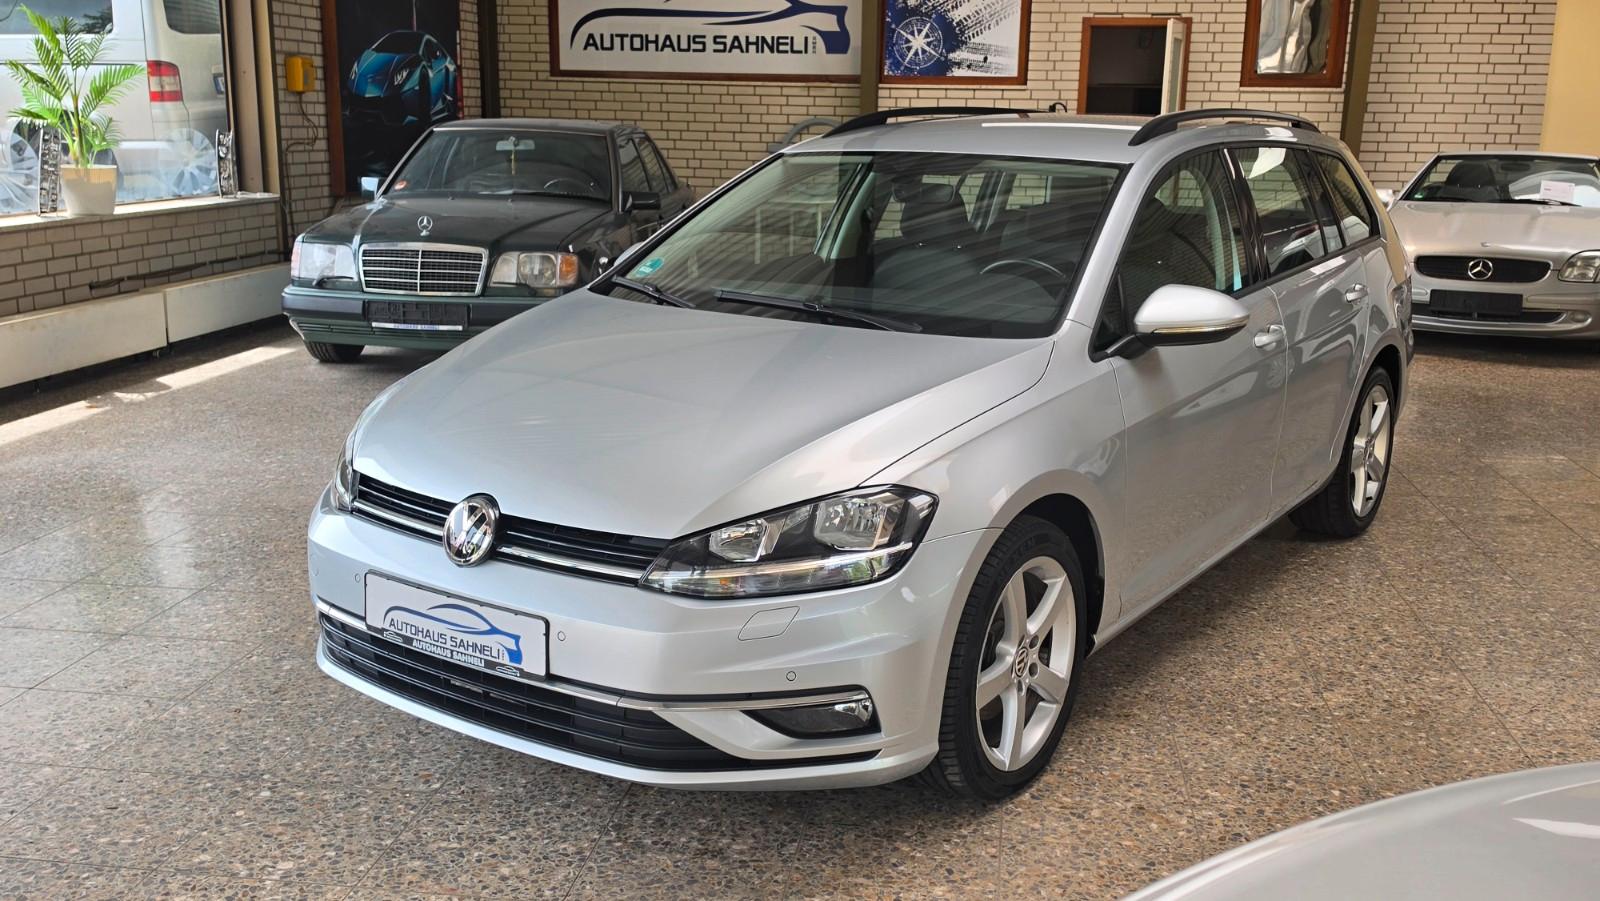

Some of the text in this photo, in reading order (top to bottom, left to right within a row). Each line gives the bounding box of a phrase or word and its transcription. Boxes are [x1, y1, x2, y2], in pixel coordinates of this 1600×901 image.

[583, 33, 706, 53] AUTOHAUS
[713, 35, 809, 54] SAHNELI
[389, 618, 447, 644] AUTOHAUS
[450, 636, 500, 659] SAHNELI
[412, 638, 452, 658] AUTOHAUS
[452, 650, 485, 667] SAHNELI
